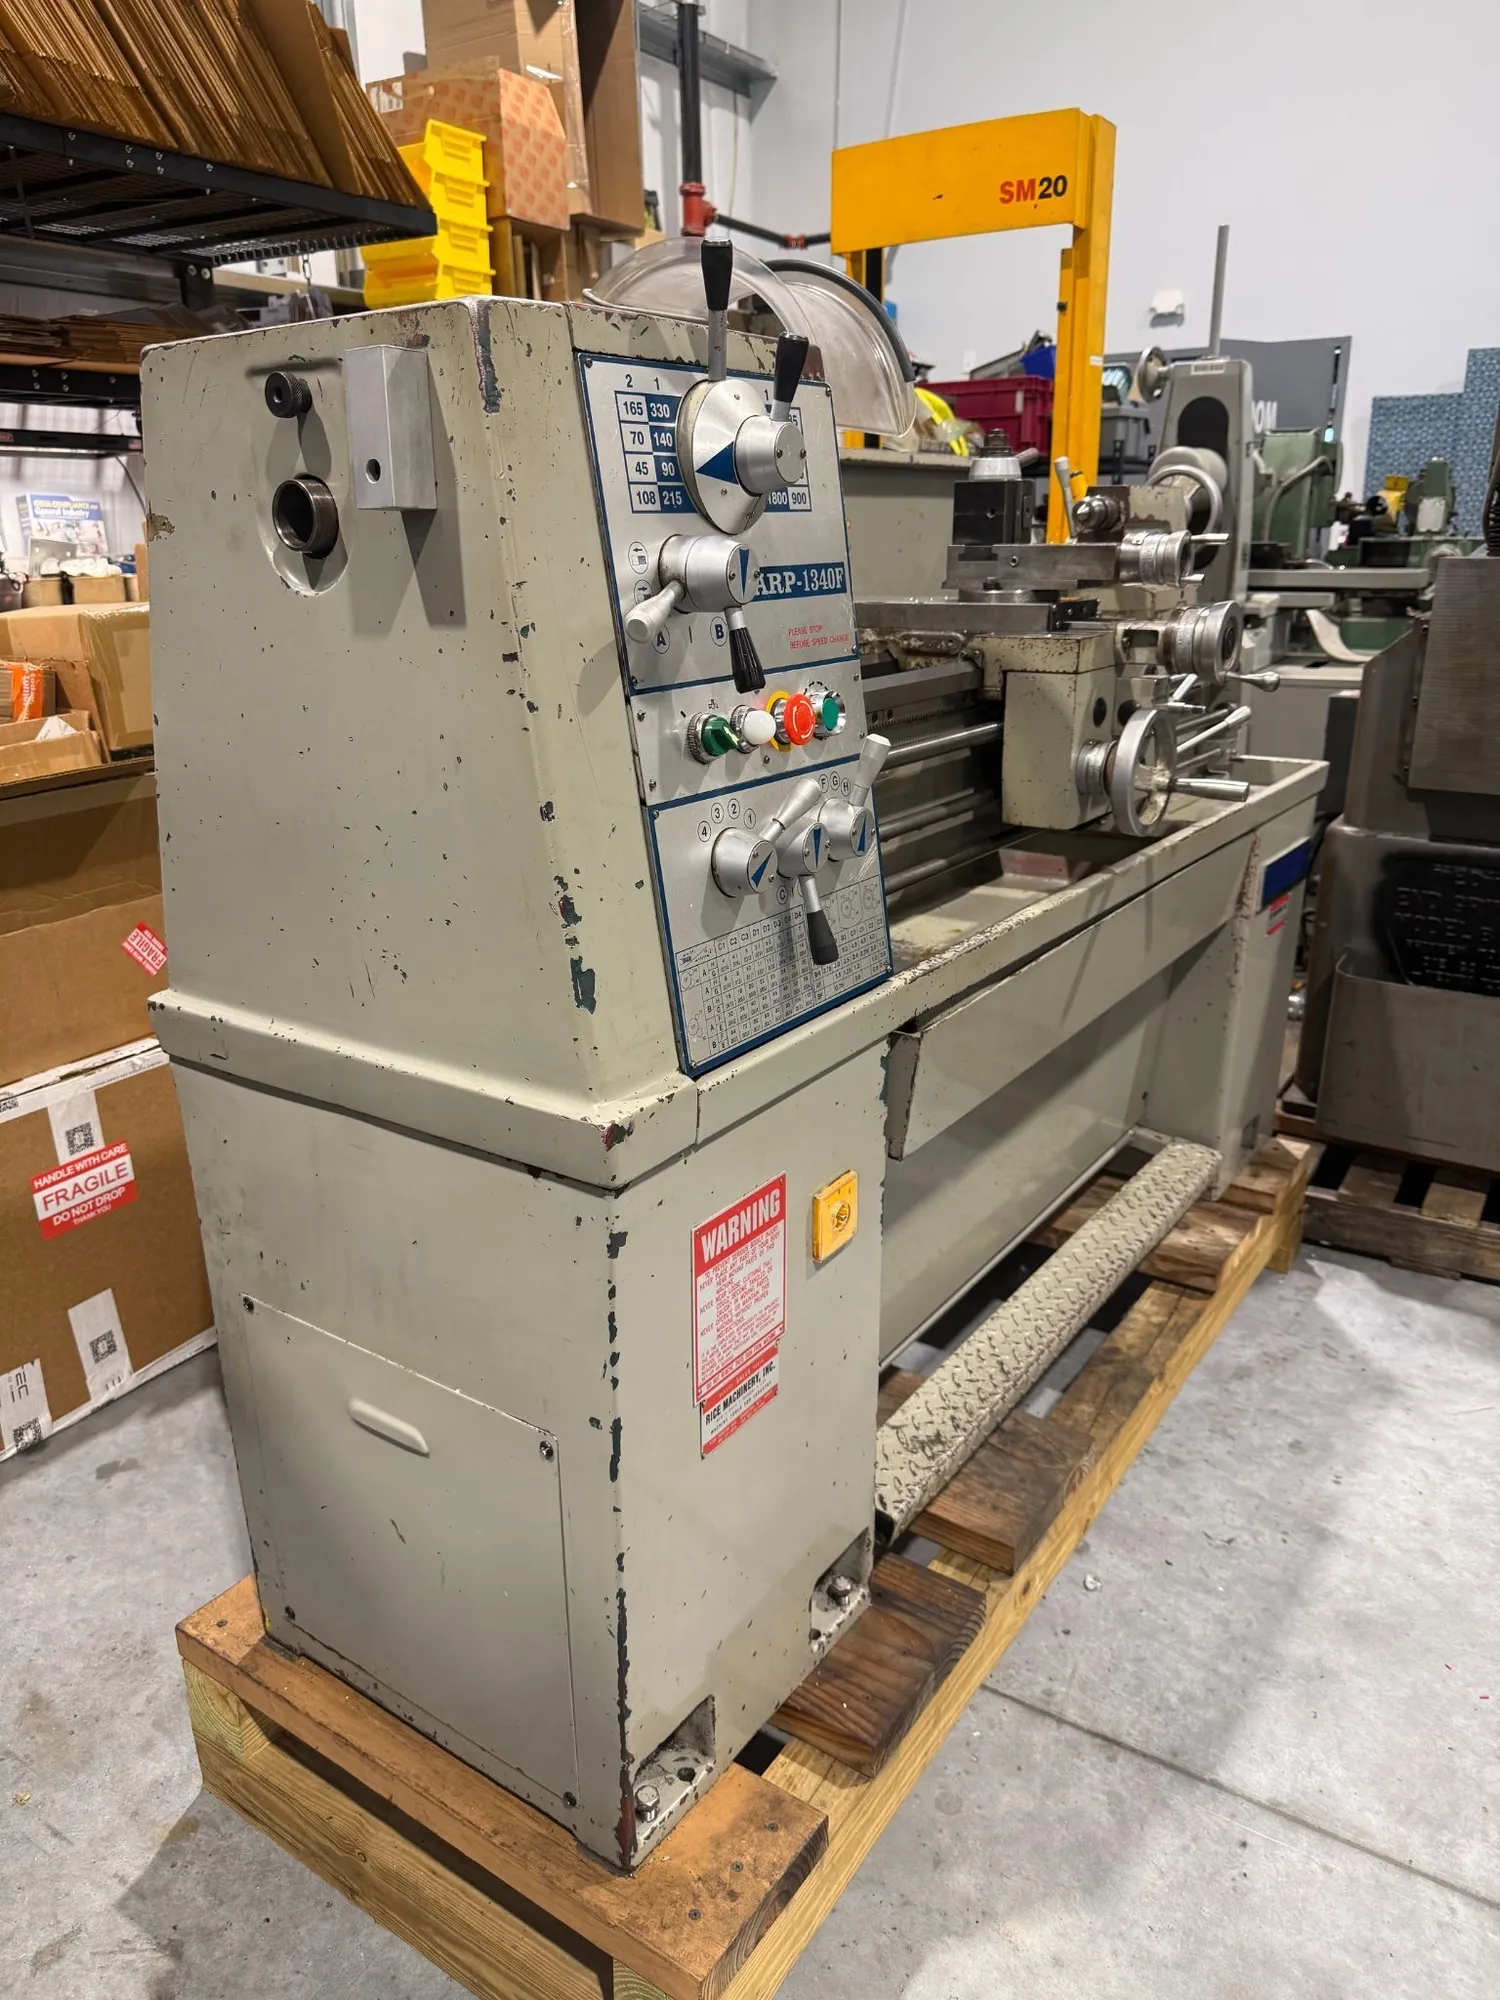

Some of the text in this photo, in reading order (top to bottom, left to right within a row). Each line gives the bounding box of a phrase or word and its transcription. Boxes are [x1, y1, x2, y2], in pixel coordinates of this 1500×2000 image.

[999, 174, 1068, 205] SM20
[625, 374, 633, 388] 2
[653, 377, 660, 391] 1
[623, 401, 671, 418] 165 330
[629, 431, 673, 447] 70 140
[635, 461, 675, 476] 45 90
[636, 490, 657, 505] 108
[662, 490, 683, 506] 215
[791, 492, 807, 505] 900
[754, 566, 844, 596] ARP-1340F
[656, 624, 724, 647] A B
[788, 626, 808, 637] PLEASE
[790, 634, 849, 650] BEFORE SPEED CHANGE
[820, 775, 849, 792] F G H
[701, 803, 752, 838] 4 3 2 1
[779, 889, 786, 900] C
[716, 940, 726, 950] C1
[728, 936, 738, 946] C2
[739, 931, 749, 941] C3
[751, 927, 760, 936] D1
[793, 910, 802, 919] D4
[129, 931, 166, 967] FRAGILE
[33, 1142, 128, 1189] HANDLE WITH CARE
[42, 1162, 129, 1212] FRAGILE
[52, 1186, 126, 1227] DO NOT DROP
[73, 1203, 112, 1226] THANK YOU
[701, 1188, 780, 1264] WARNING
[705, 1407, 721, 1426] RICE
[723, 1373, 761, 1410] MACHINERY,
[762, 1360, 776, 1377] INC.
